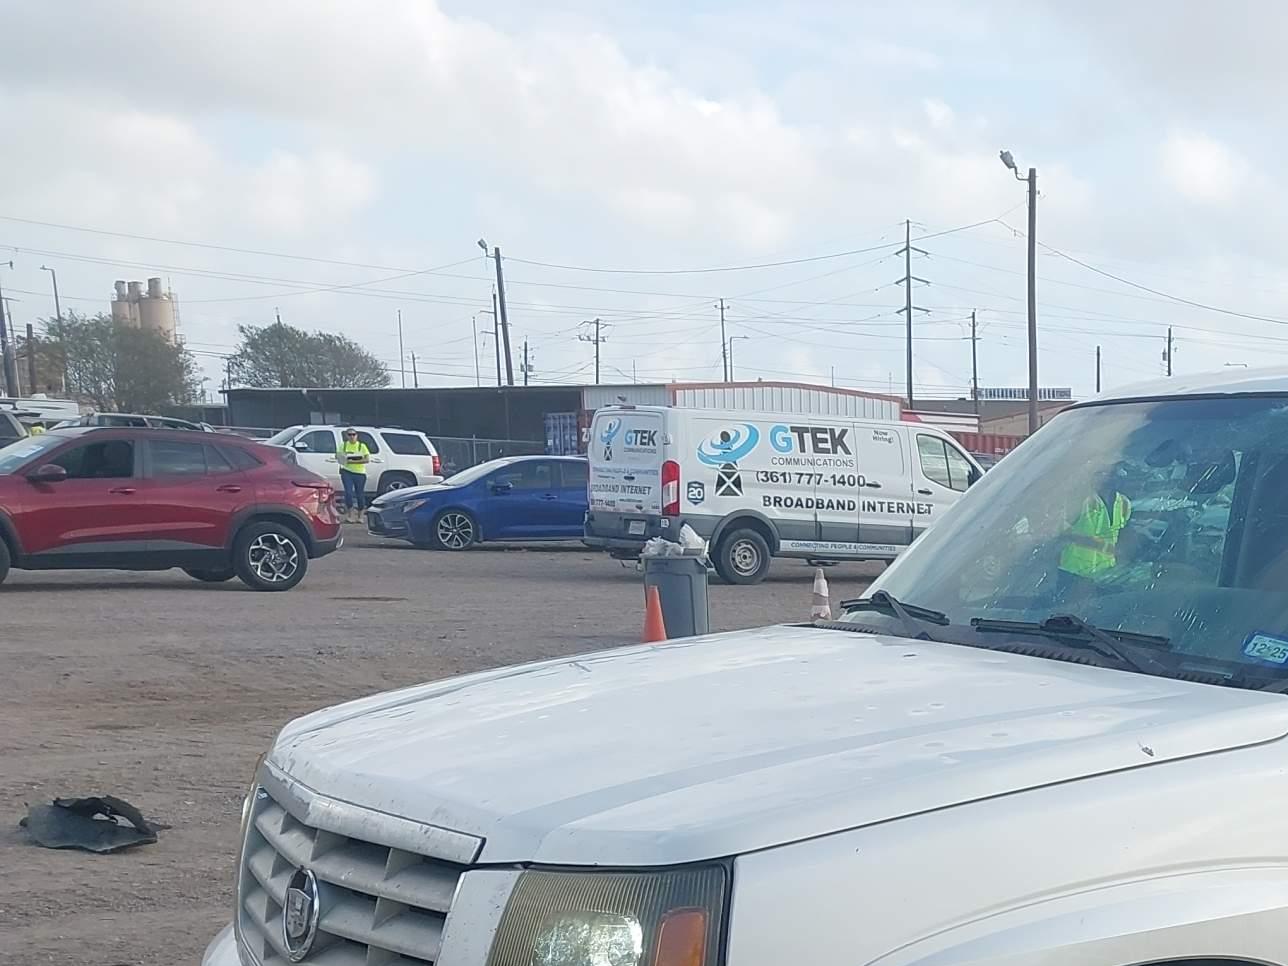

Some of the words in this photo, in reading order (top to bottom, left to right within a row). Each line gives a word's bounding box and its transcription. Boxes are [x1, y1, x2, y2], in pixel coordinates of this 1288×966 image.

[624, 430, 658, 446] GTEK
[769, 424, 852, 455] GTEK
[771, 457, 855, 468] COMMUNICATIONS
[756, 471, 792, 484] (361)
[795, 472, 866, 488] 777-1400
[620, 485, 653, 496] INTERNET
[687, 486, 703, 499] 20
[762, 495, 856, 511] BROADBAND
[862, 500, 934, 515] INTERNET
[859, 544, 897, 552] COMMUNITIES
